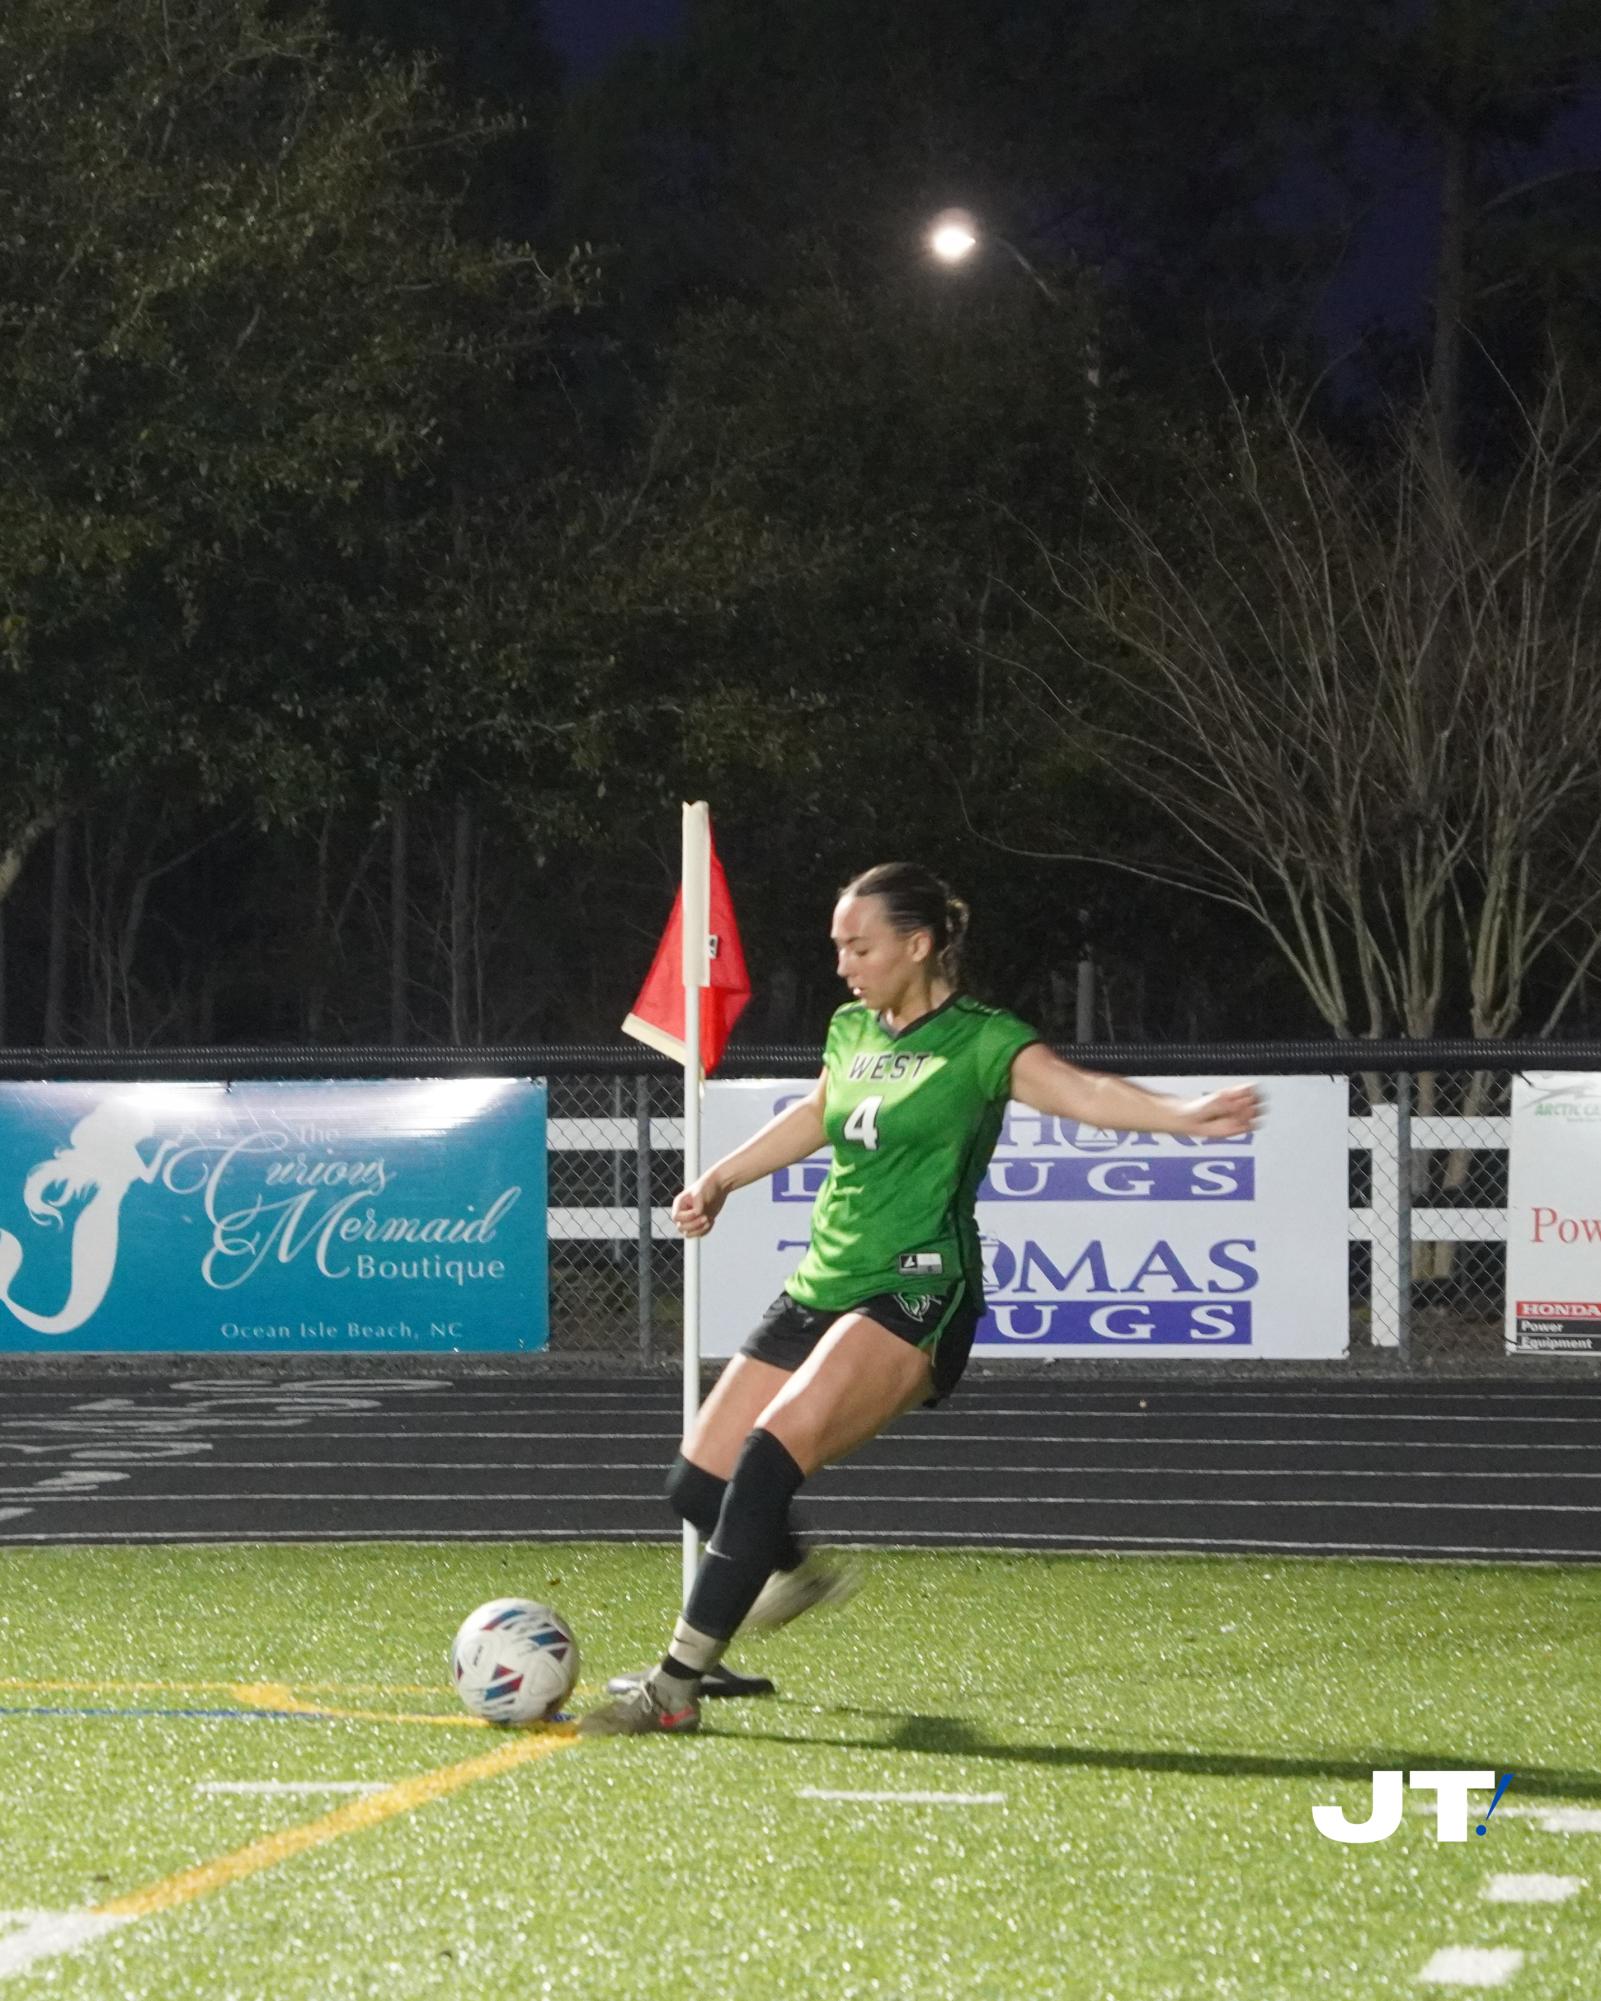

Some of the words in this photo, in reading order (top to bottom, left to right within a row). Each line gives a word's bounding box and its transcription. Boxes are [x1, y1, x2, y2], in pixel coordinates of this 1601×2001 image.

[847, 1051, 932, 1080] WEST
[843, 1095, 884, 1151] 4
[162, 1131, 397, 1231] Curious
[201, 1186, 522, 1290] Mermaid
[357, 1254, 505, 1287] Boutique
[1522, 1303, 1601, 1316] HONDA
[220, 1322, 291, 1339] Ocean
[300, 1321, 339, 1339] Isle
[347, 1321, 420, 1342] Beach,
[430, 1322, 463, 1338] NC
[1521, 1320, 1564, 1332] Power
[1521, 1336, 1593, 1350] Equipment
